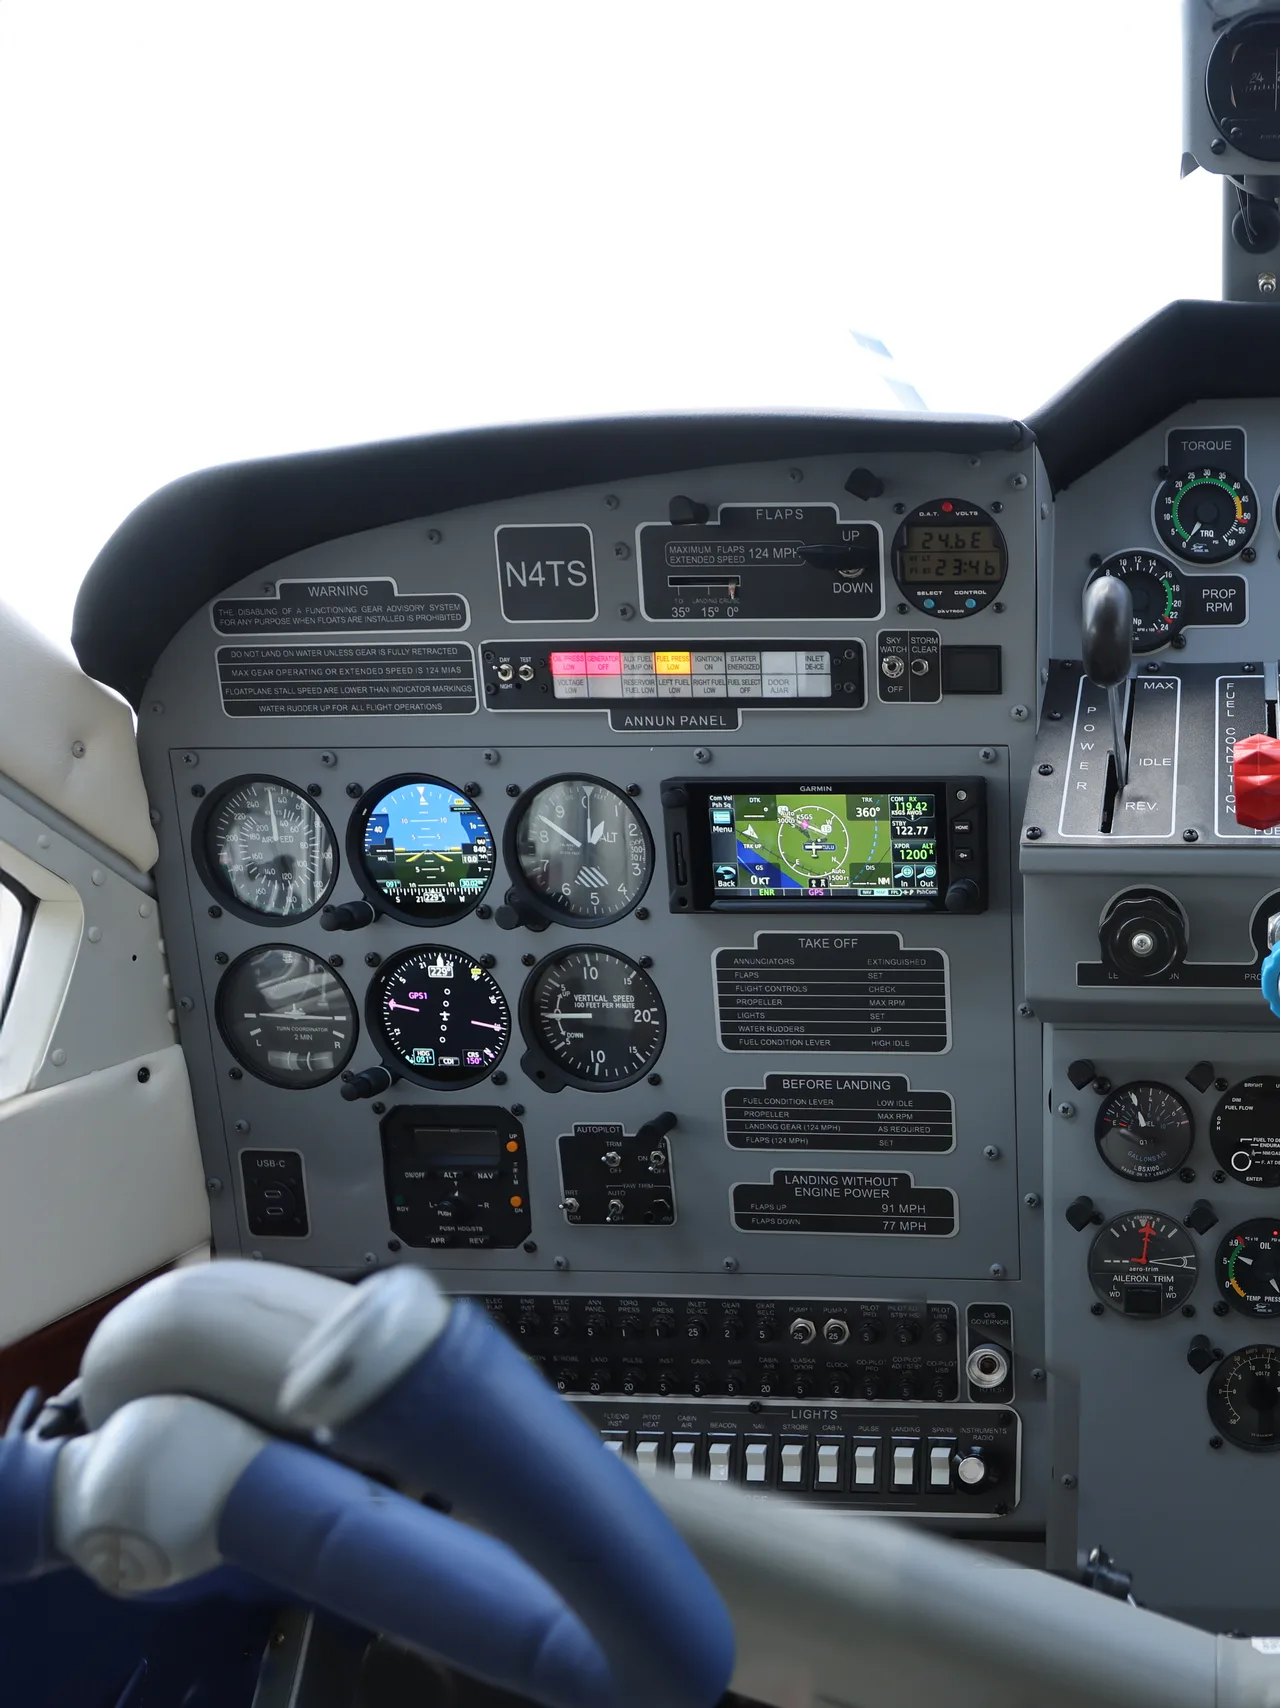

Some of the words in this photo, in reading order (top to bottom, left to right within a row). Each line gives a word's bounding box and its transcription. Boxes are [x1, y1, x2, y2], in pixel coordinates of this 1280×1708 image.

[1250, 73, 1263, 83] 24
[1181, 440, 1232, 450] TORQUE
[756, 509, 803, 520] FLAPS
[842, 531, 859, 541] UP
[505, 560, 587, 587] N4TS
[308, 585, 368, 597] WARNING
[833, 583, 873, 593] DOWN
[1202, 589, 1236, 599] PROP
[1206, 602, 1233, 612] RPM
[624, 716, 676, 726] ANNUN
[680, 715, 726, 726] PANEL
[1076, 707, 1096, 789] POWER
[1140, 758, 1171, 766] IDLE
[894, 802, 927, 812] 119.42
[1125, 802, 1158, 810] REV.
[855, 807, 880, 817] 360°
[712, 825, 732, 833] Menu
[895, 826, 928, 835] 122.77
[900, 850, 926, 860] 1200
[920, 879, 933, 887] Out
[808, 888, 824, 896] GPS
[799, 939, 829, 948] TAKE
[834, 939, 858, 948] OFF
[408, 992, 428, 1000] GPS1
[574, 994, 606, 1002] VERTICAL
[612, 995, 635, 1003] SPEED
[782, 1079, 832, 1090] BEFORE
[837, 1080, 891, 1091] LANDING
[576, 1126, 620, 1134] AUTOPILOT
[256, 1159, 285, 1168] USB-C
[477, 1172, 494, 1180] NAV
[785, 1175, 838, 1186] LANDING
[842, 1177, 898, 1187] WITHOUT
[795, 1187, 840, 1197] ENGINE
[844, 1188, 889, 1198] POWER
[882, 1204, 894, 1213] 91
[899, 1205, 925, 1214] MPH
[883, 1221, 895, 1230] 77
[900, 1222, 926, 1231] MPH
[1113, 1275, 1148, 1283] AILERON
[1151, 1275, 1174, 1283] TRIM
[791, 1409, 838, 1420] LIGHTS
